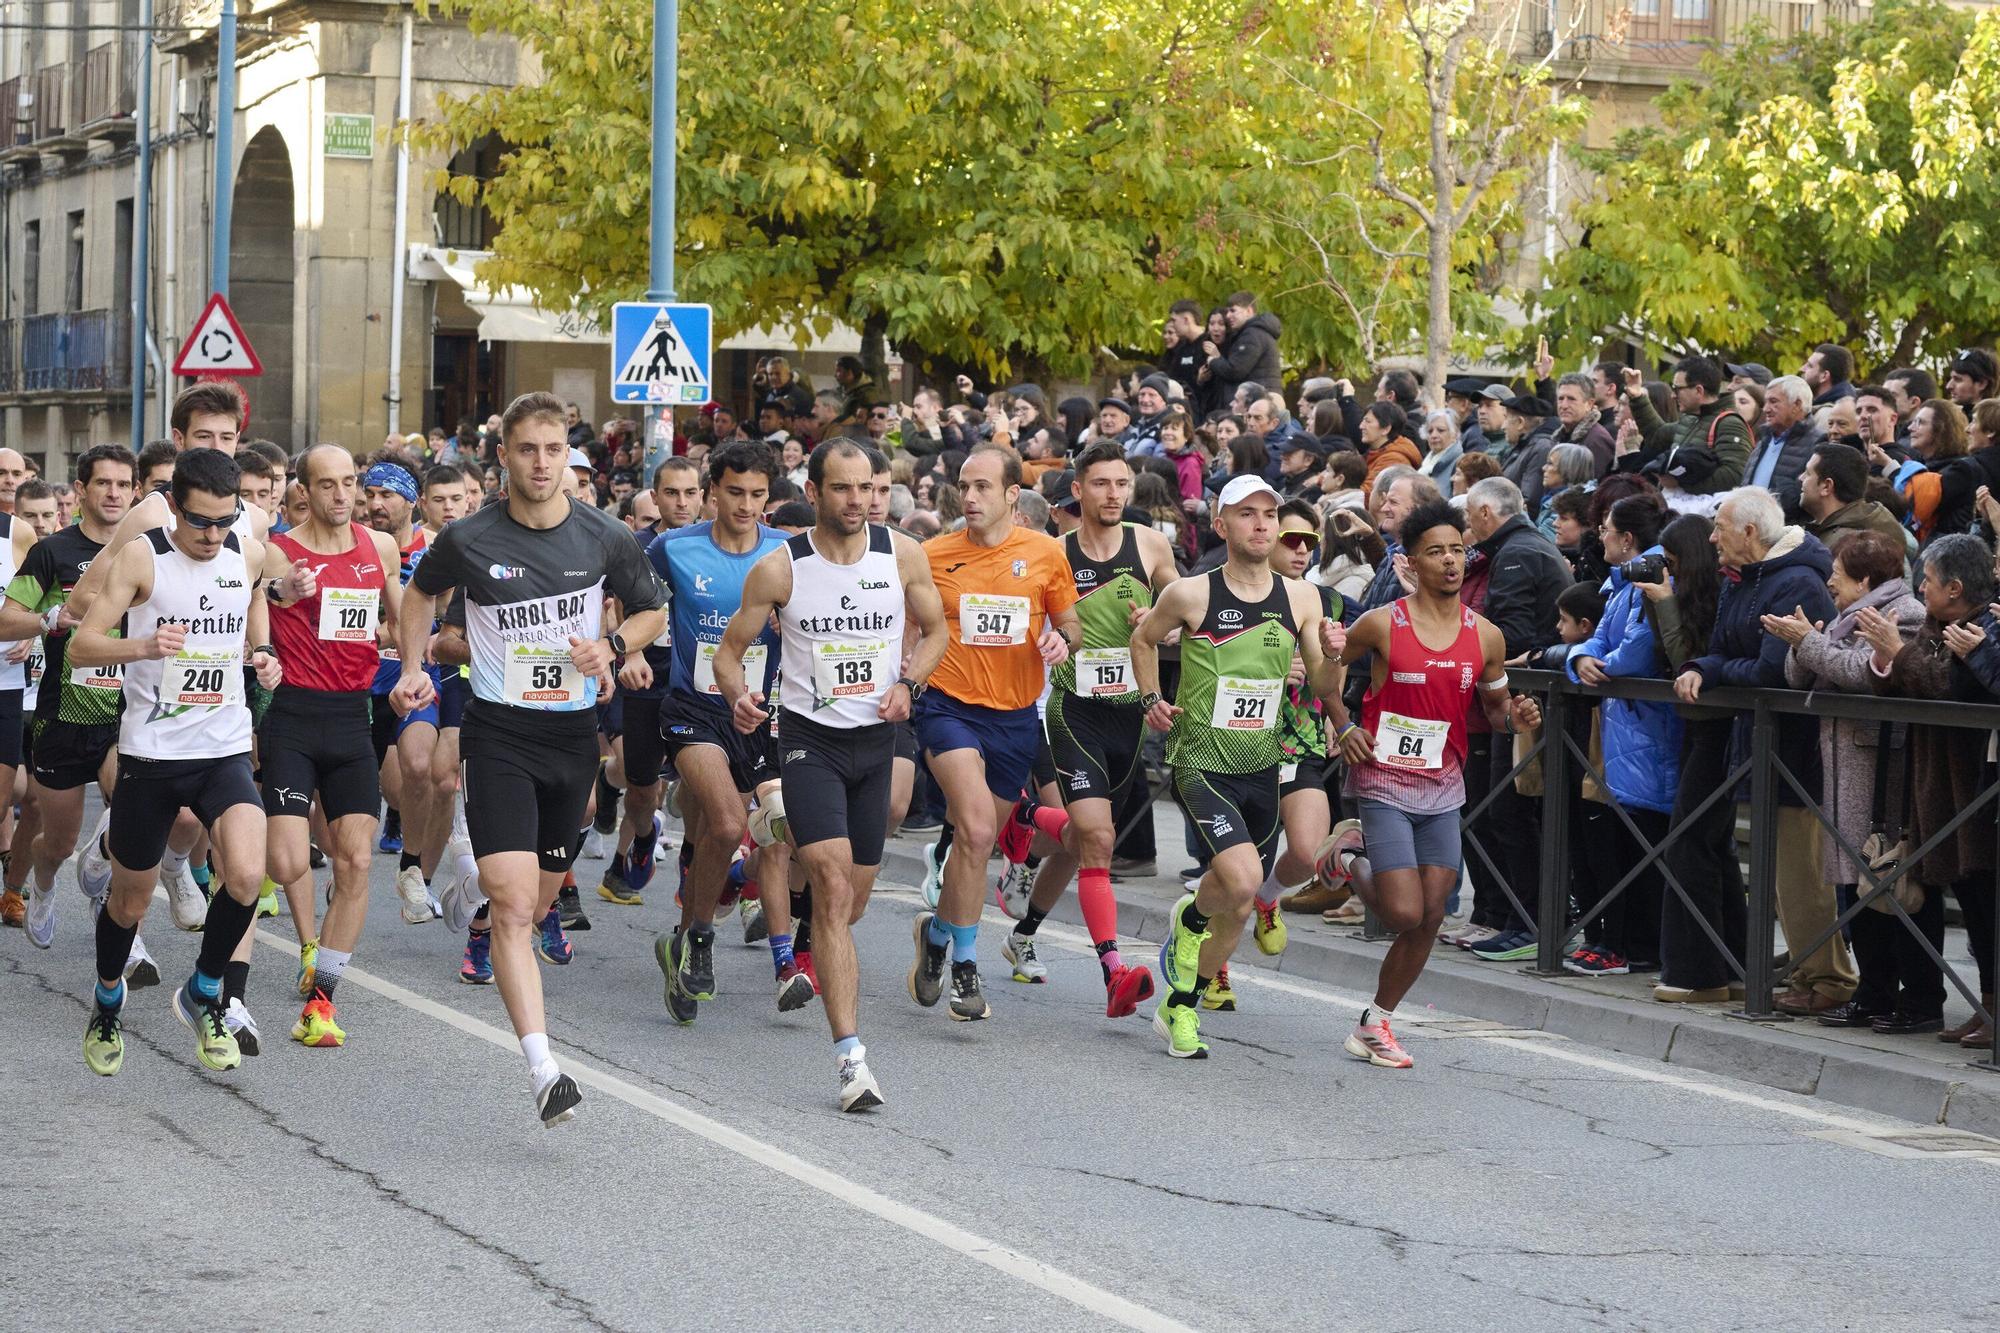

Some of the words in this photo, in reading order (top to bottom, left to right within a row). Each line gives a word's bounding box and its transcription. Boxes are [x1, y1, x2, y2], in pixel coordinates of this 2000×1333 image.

[328, 126, 370, 136] FRANCISCO
[339, 608, 367, 628] 120
[496, 602, 550, 630] KIROL
[558, 593, 587, 620] BAT
[800, 612, 893, 632] etxenike
[977, 614, 1011, 634] 347
[336, 631, 366, 639] navarban
[974, 635, 1011, 644] navarban
[532, 665, 562, 689] 53
[834, 660, 872, 684] 133
[1095, 666, 1124, 684] 157
[88, 678, 120, 688] navarban
[182, 669, 224, 692] 240
[525, 690, 568, 700] navarban
[834, 684, 874, 695] navarban
[1093, 685, 1126, 694] navarban
[180, 694, 222, 703] navarban
[1234, 698, 1266, 718] 321
[1230, 720, 1264, 728] navarban
[1398, 736, 1424, 756] 64
[1389, 756, 1426, 766] navarban
